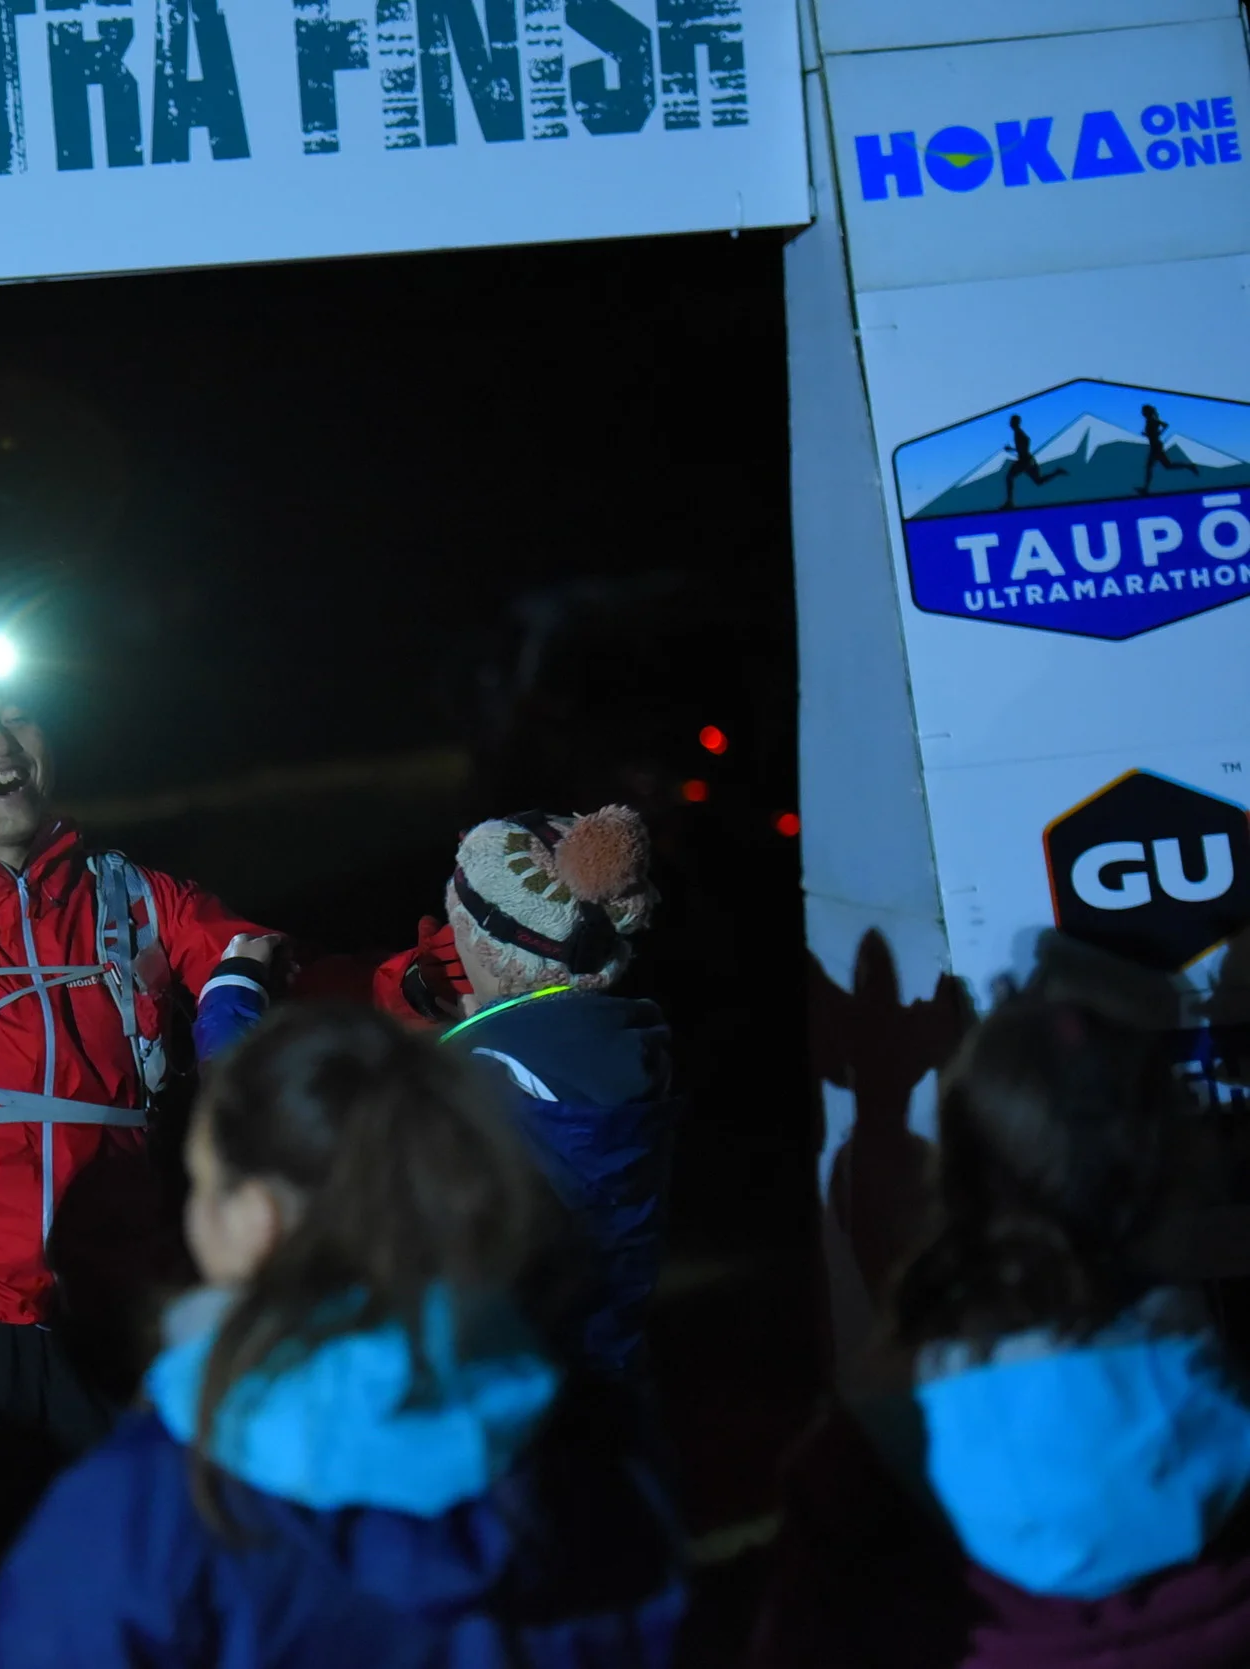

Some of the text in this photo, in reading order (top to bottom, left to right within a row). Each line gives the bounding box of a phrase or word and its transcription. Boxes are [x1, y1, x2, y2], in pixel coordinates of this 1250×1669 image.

[1141, 96, 1237, 135] ONE
[855, 110, 1145, 201] HOKA
[1147, 132, 1241, 170] ONE
[1221, 762, 1242, 774] TM
[1070, 832, 1236, 911] GU
